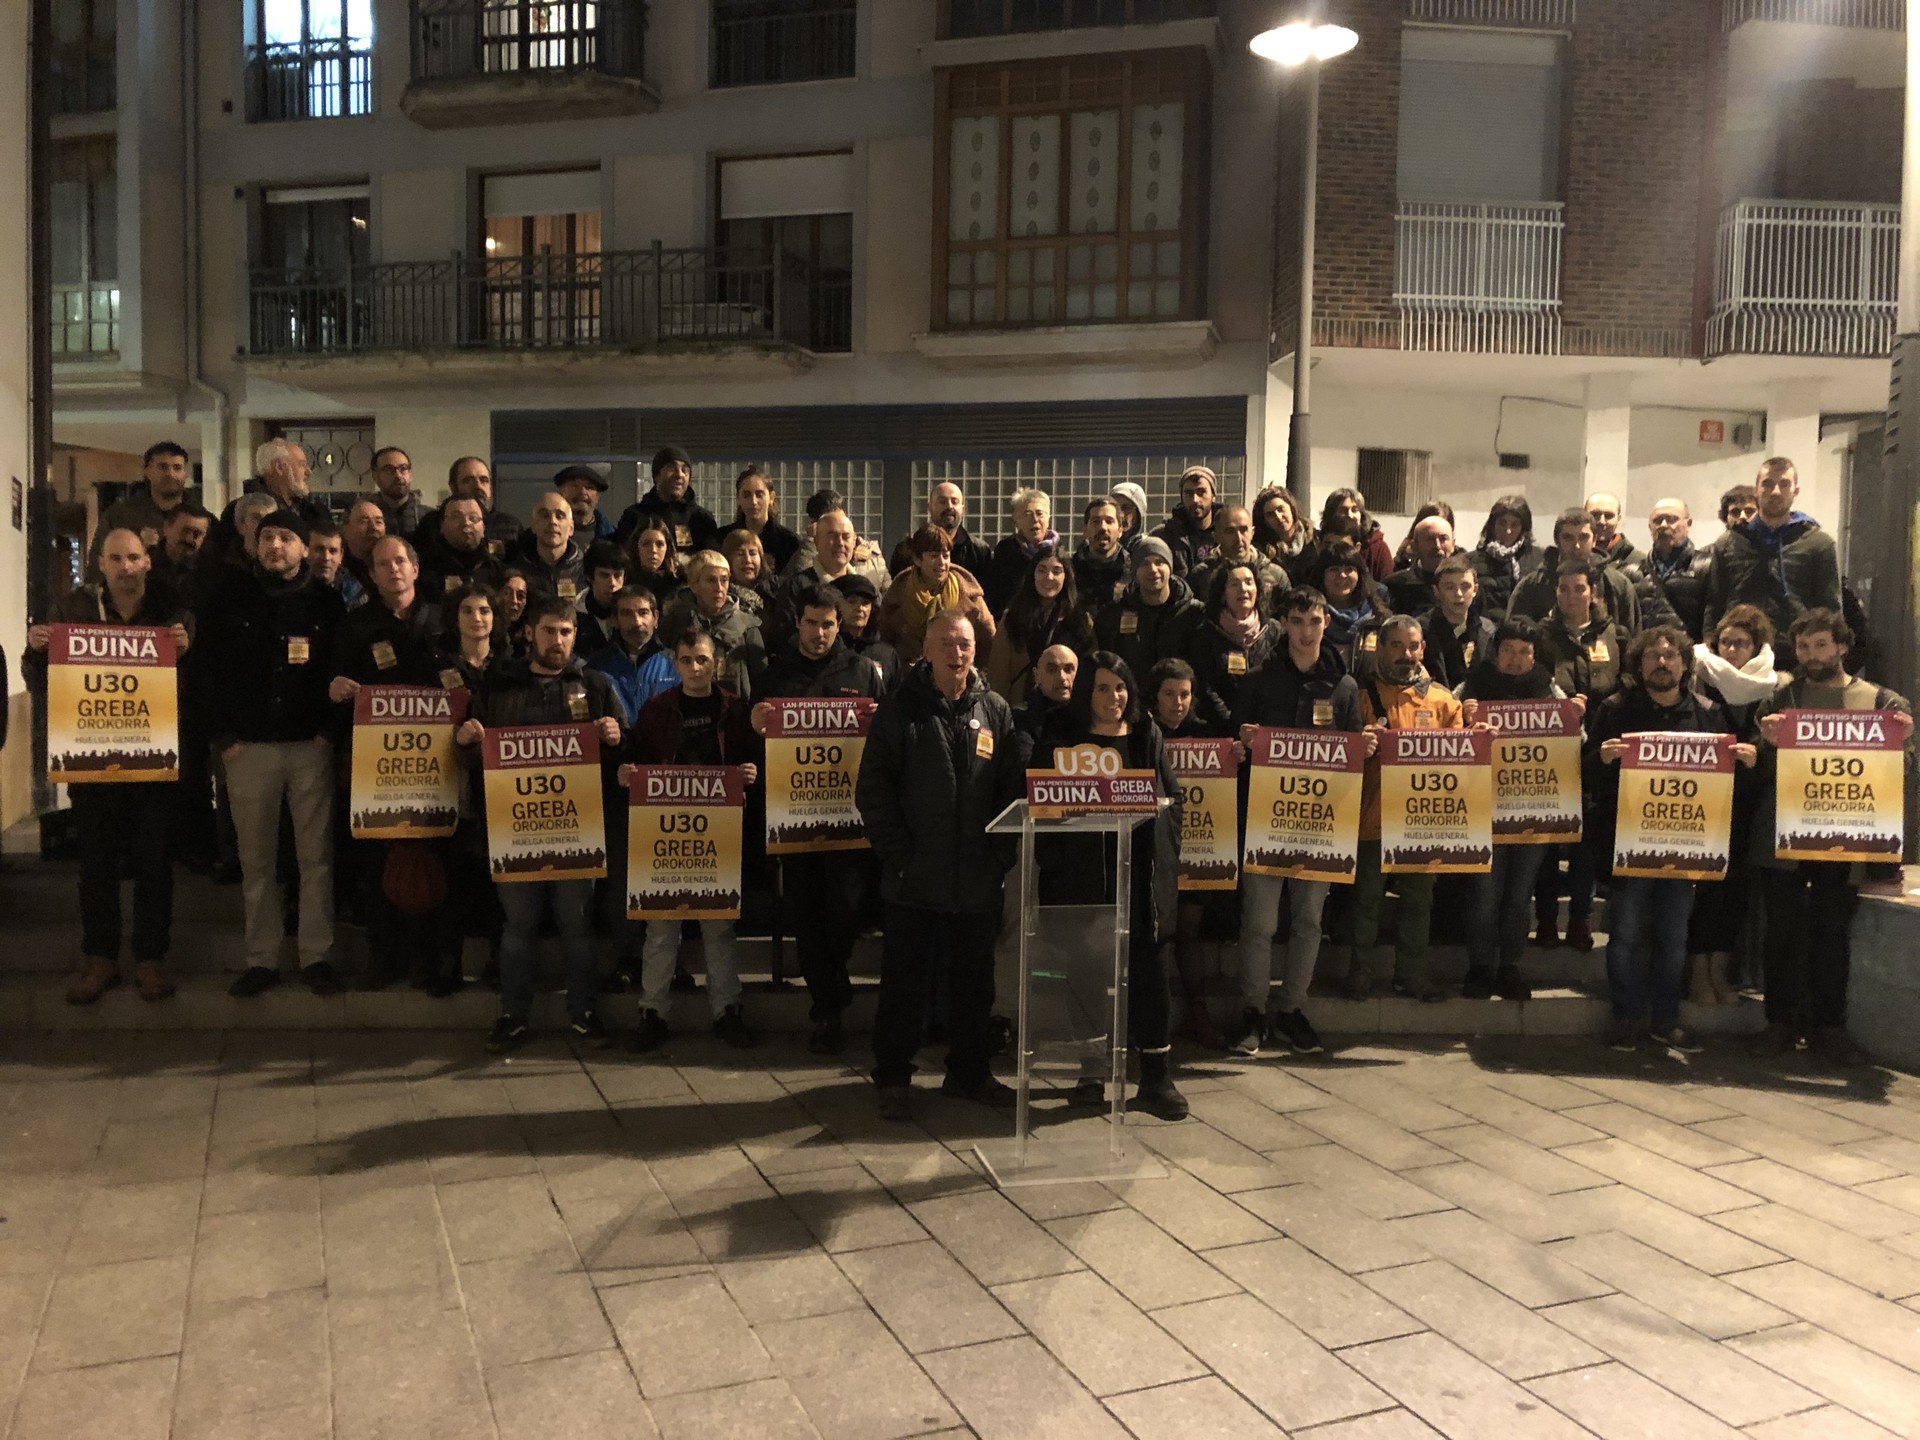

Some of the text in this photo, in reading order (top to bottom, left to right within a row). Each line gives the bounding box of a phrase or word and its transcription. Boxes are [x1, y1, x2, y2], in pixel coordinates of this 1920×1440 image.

[326, 454, 332, 464] 4
[68, 636, 158, 657] DUINA
[84, 674, 138, 693] U30
[78, 700, 150, 717] GREBA
[372, 698, 451, 716] DUINA
[77, 719, 150, 729] OROKORRA
[783, 709, 859, 729] DUINA
[1488, 711, 1564, 730] DUINA
[1796, 721, 1885, 742] DUINA
[384, 733, 431, 751] U30
[500, 737, 582, 760] DUINA
[1398, 738, 1475, 756] DUINA
[796, 746, 842, 765] U30
[1172, 750, 1221, 769] UINA
[1269, 740, 1348, 763] DUINA
[1501, 745, 1547, 763] U30
[1638, 742, 1718, 764] DUINA
[377, 758, 440, 774] GREBA
[1058, 751, 1119, 776] U30
[1811, 758, 1864, 776] U30
[376, 776, 440, 786] OROKORRA
[516, 775, 566, 795] U30
[791, 771, 851, 789] GREBA
[1411, 773, 1458, 791] U30
[1498, 768, 1558, 785] GREBA
[648, 778, 726, 797] DUINA
[790, 790, 851, 801] OROKORRA
[1034, 787, 1101, 802] DUINA
[1110, 780, 1153, 793] GREBA
[1181, 786, 1204, 804] 30
[1280, 776, 1327, 797] U30
[1497, 786, 1559, 797] OROKORRA
[1651, 778, 1697, 797] U30
[1805, 782, 1875, 800] GREBA
[406, 792, 440, 801] GENERAL
[1112, 794, 1153, 803] OROKORRA
[513, 800, 578, 819] GREBA
[789, 806, 852, 816] HUELGA GENERAL
[1273, 800, 1334, 820] GREBA
[1406, 798, 1467, 814] GREBA
[1643, 802, 1706, 820] GREBA
[1804, 800, 1875, 812] OROKORRA
[513, 818, 579, 832] OROKORRA
[660, 815, 708, 833] U30
[1182, 811, 1213, 828] EBA
[1271, 818, 1334, 833] OROKORRA
[1406, 815, 1468, 826] OROKORRA
[1641, 820, 1705, 832] OROKORRA
[1837, 818, 1876, 827] GENERAL
[512, 836, 581, 846] HUELGA GENERAL
[1181, 829, 1214, 840] ORRA
[1268, 834, 1334, 847] HUELGA GENERAL
[1639, 837, 1705, 846] HUELGA GENERAL
[654, 840, 717, 856] GREBA
[653, 859, 717, 869] OROKORRA
